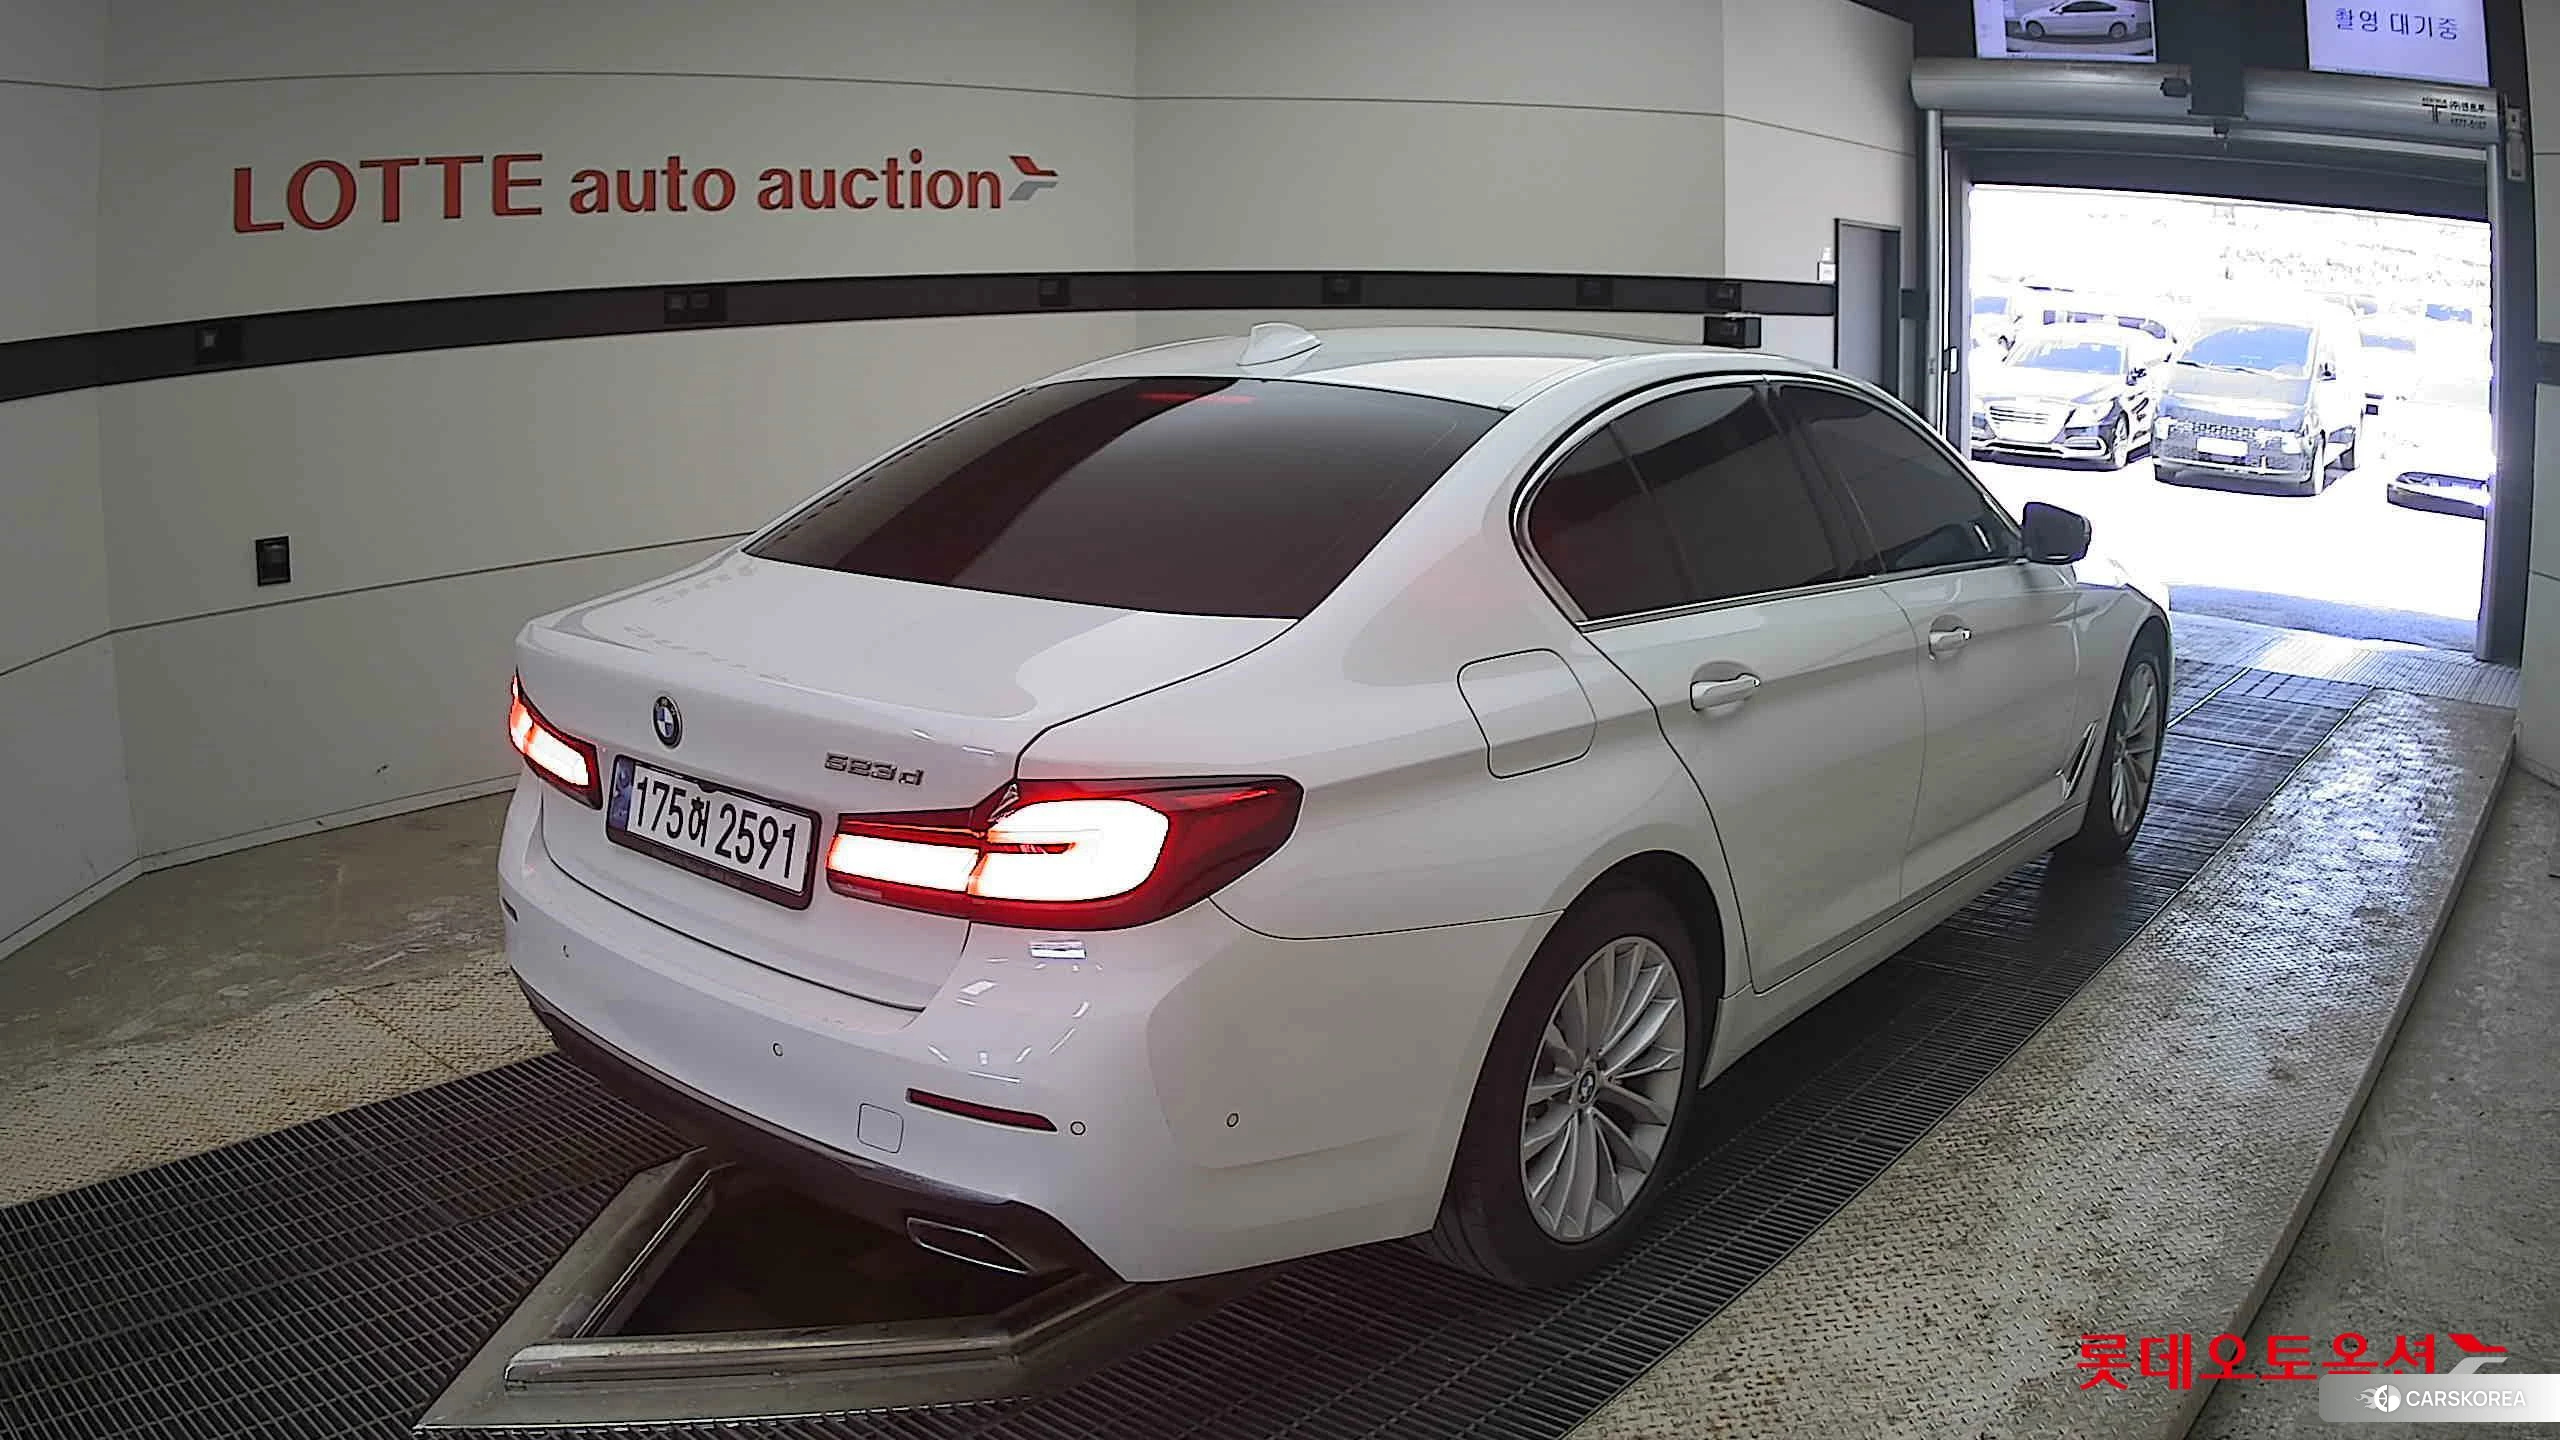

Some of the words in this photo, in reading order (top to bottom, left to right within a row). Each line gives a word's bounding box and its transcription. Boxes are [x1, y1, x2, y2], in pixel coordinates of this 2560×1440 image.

[2390, 12, 2457, 40] 대기중
[234, 153, 543, 234] LOTTE
[569, 155, 737, 212] auto
[757, 150, 1005, 210] auction
[714, 802, 797, 879] 2591
